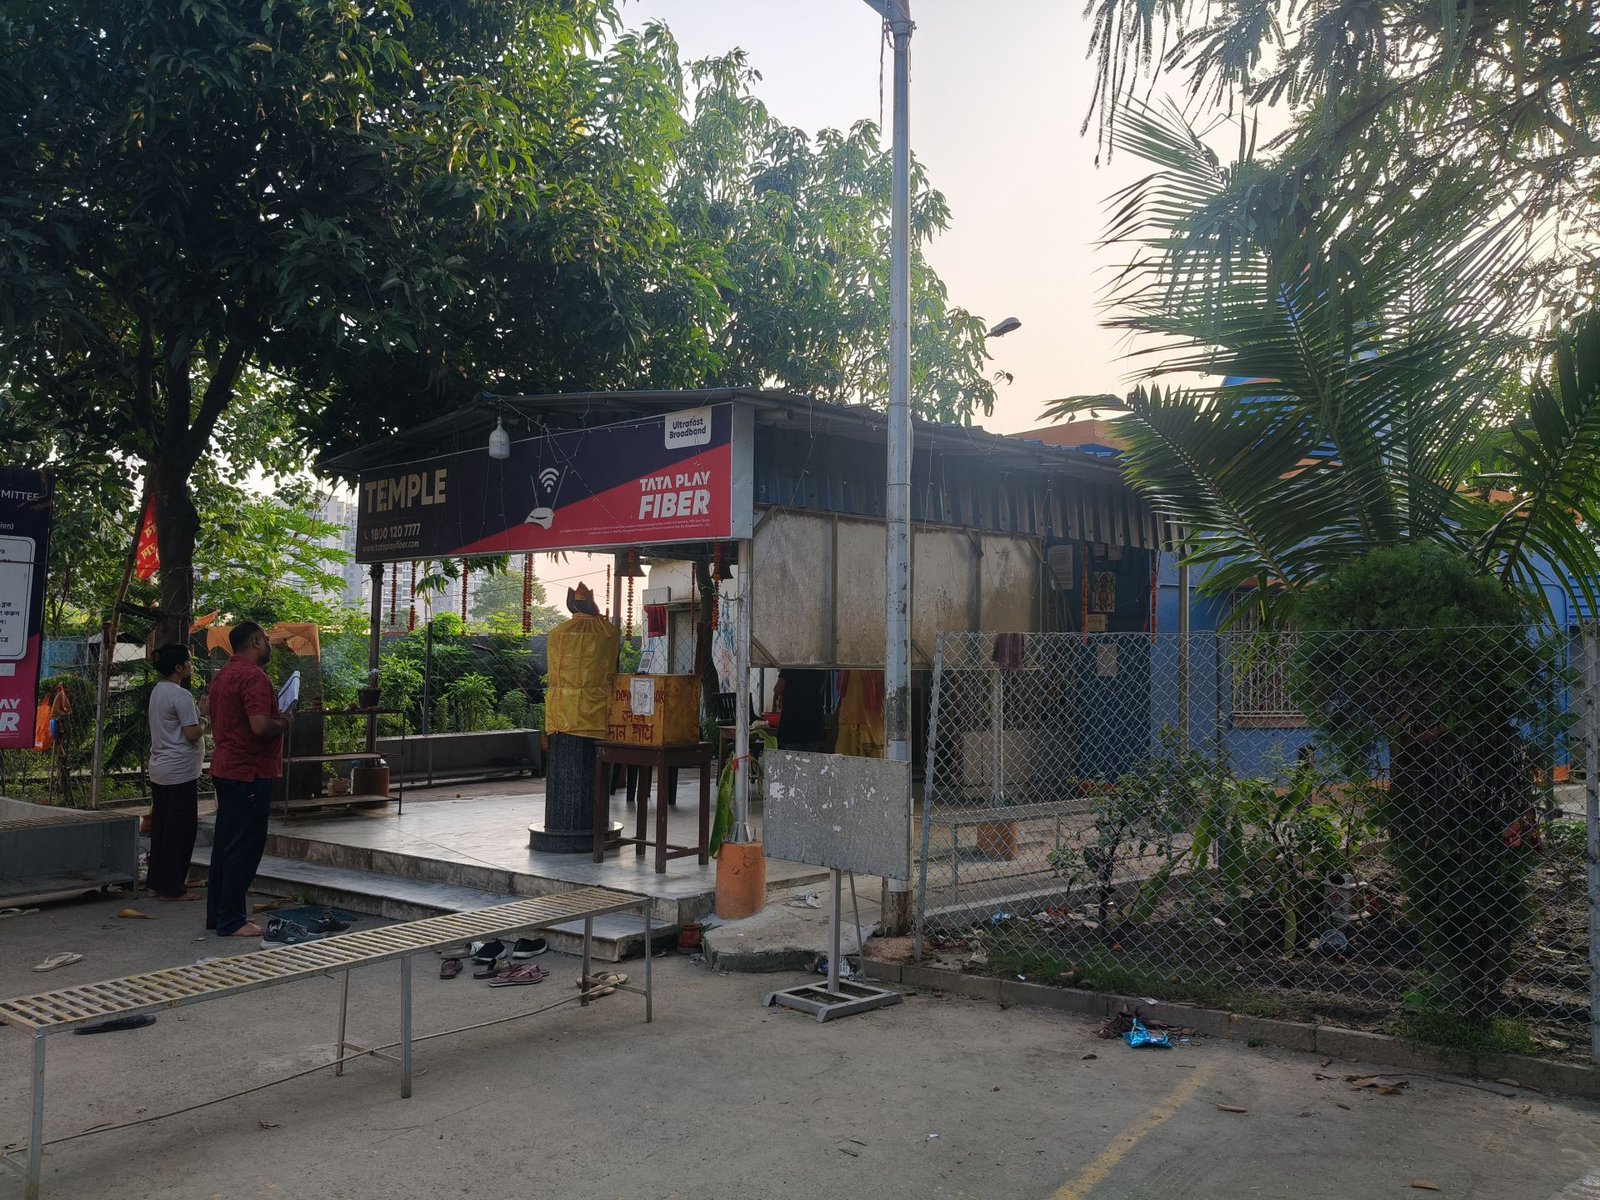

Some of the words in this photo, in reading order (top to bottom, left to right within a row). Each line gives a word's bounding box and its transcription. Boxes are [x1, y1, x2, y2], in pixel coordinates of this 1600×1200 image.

[669, 426, 706, 439] Broadband
[672, 417, 703, 430] Ultrafast
[365, 468, 447, 513] TEMPLE
[640, 475, 672, 492] TATA
[675, 470, 710, 488] PLAY
[638, 489, 710, 520] FIBER
[371, 527, 388, 541] 1800
[390, 525, 402, 538] 120
[404, 523, 421, 536] 7777
